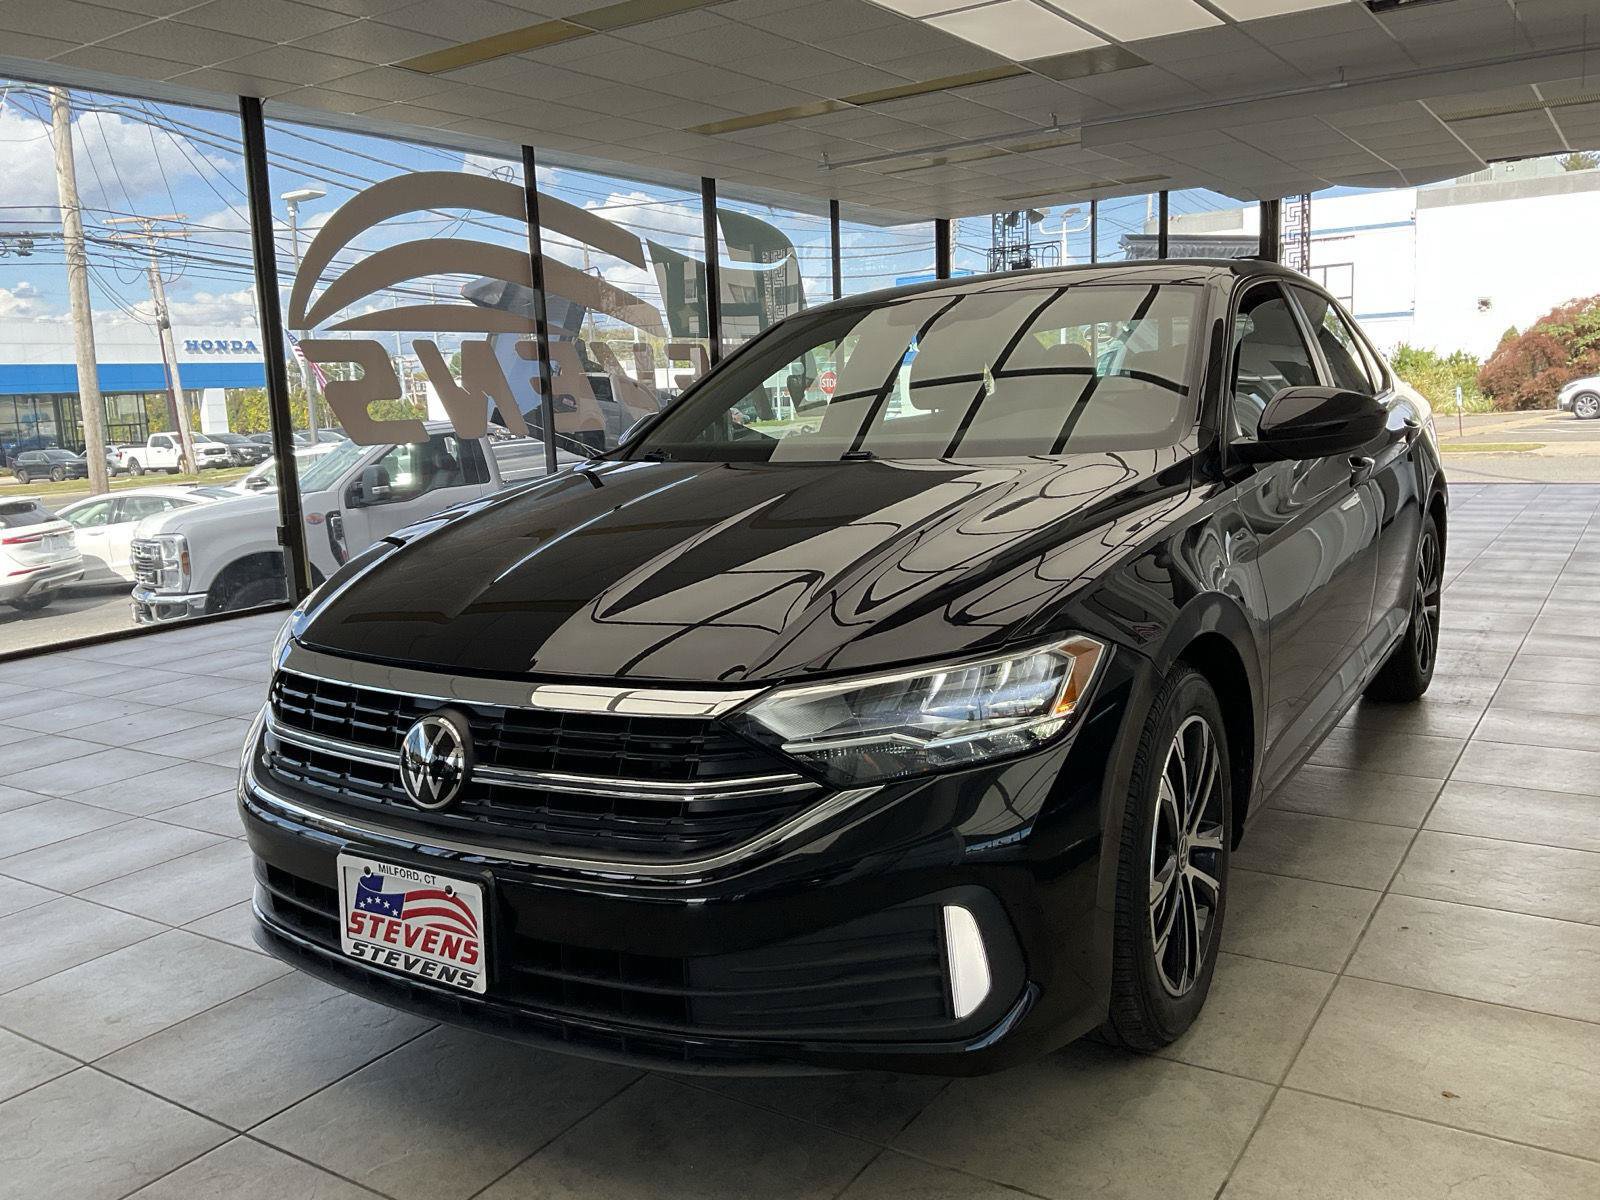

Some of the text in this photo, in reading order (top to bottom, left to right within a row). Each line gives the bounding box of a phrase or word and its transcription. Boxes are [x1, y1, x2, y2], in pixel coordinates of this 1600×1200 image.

[184, 340, 258, 352] HONDA
[378, 864, 437, 885] MILFORD, CT
[348, 911, 479, 965] STEVENS
[351, 942, 478, 988] STEVENS
